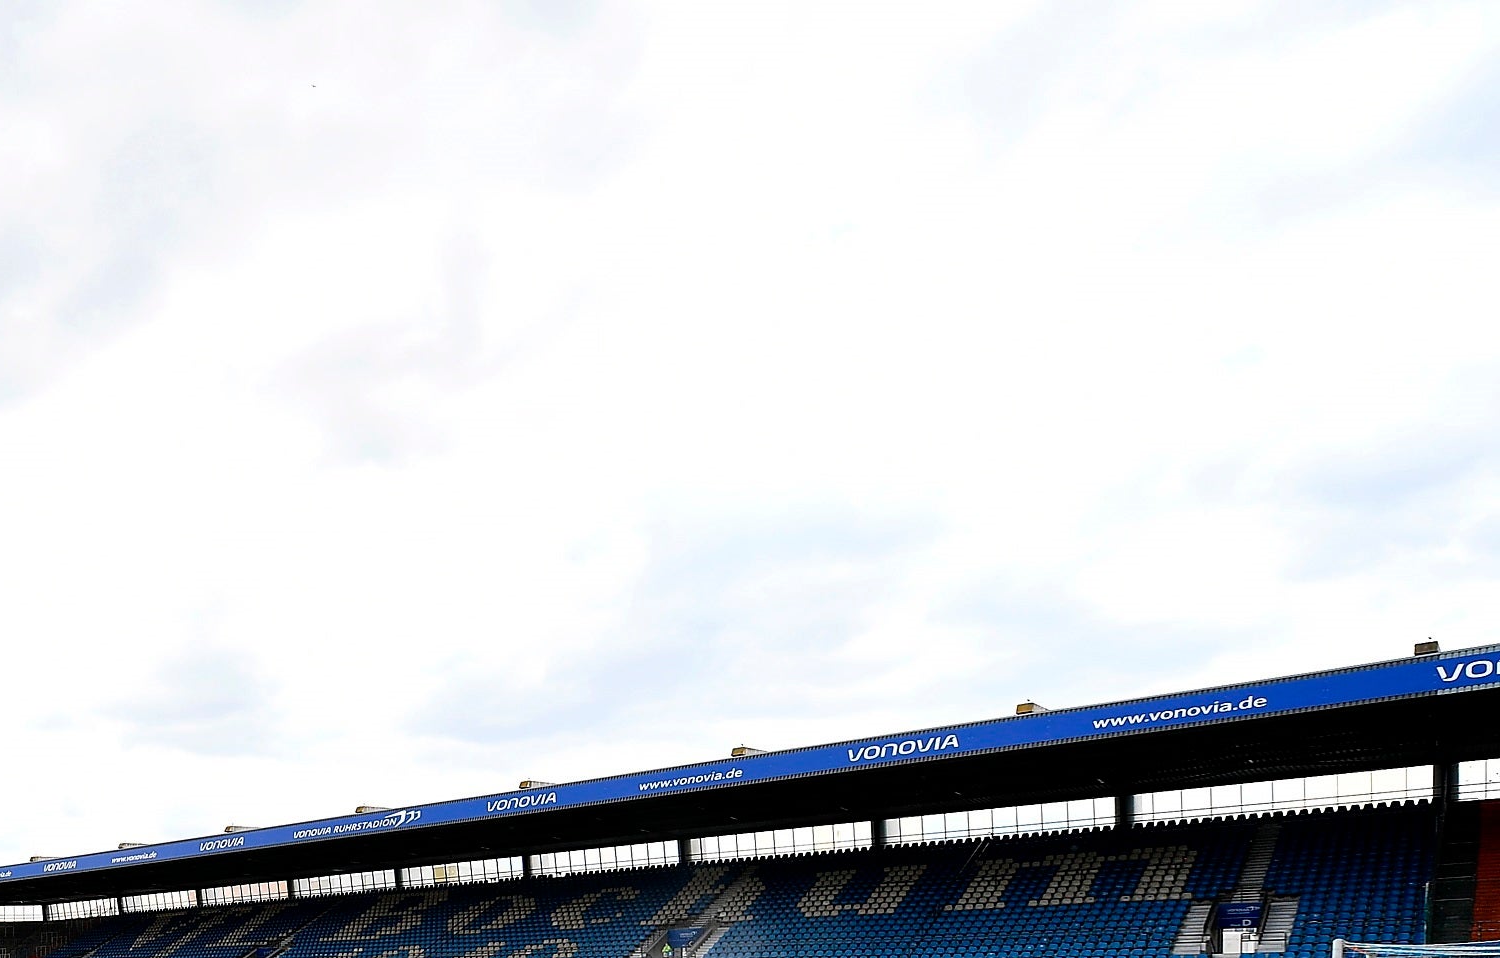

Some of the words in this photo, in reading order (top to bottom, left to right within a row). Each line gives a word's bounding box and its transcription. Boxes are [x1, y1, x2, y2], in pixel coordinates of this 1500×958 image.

[1436, 660, 1500, 682] VO
[1092, 695, 1268, 729] www.vonovia.de
[847, 734, 959, 762] VONOVIA
[638, 767, 743, 791] www.vonovia.de
[486, 792, 557, 812] VONOVIA
[293, 827, 331, 839] VONOVIA
[333, 817, 398, 833] RUHRSTADION
[200, 836, 244, 851] VONOVIA
[43, 860, 77, 873] VONOVIA
[111, 850, 157, 864] www.vonovia.de
